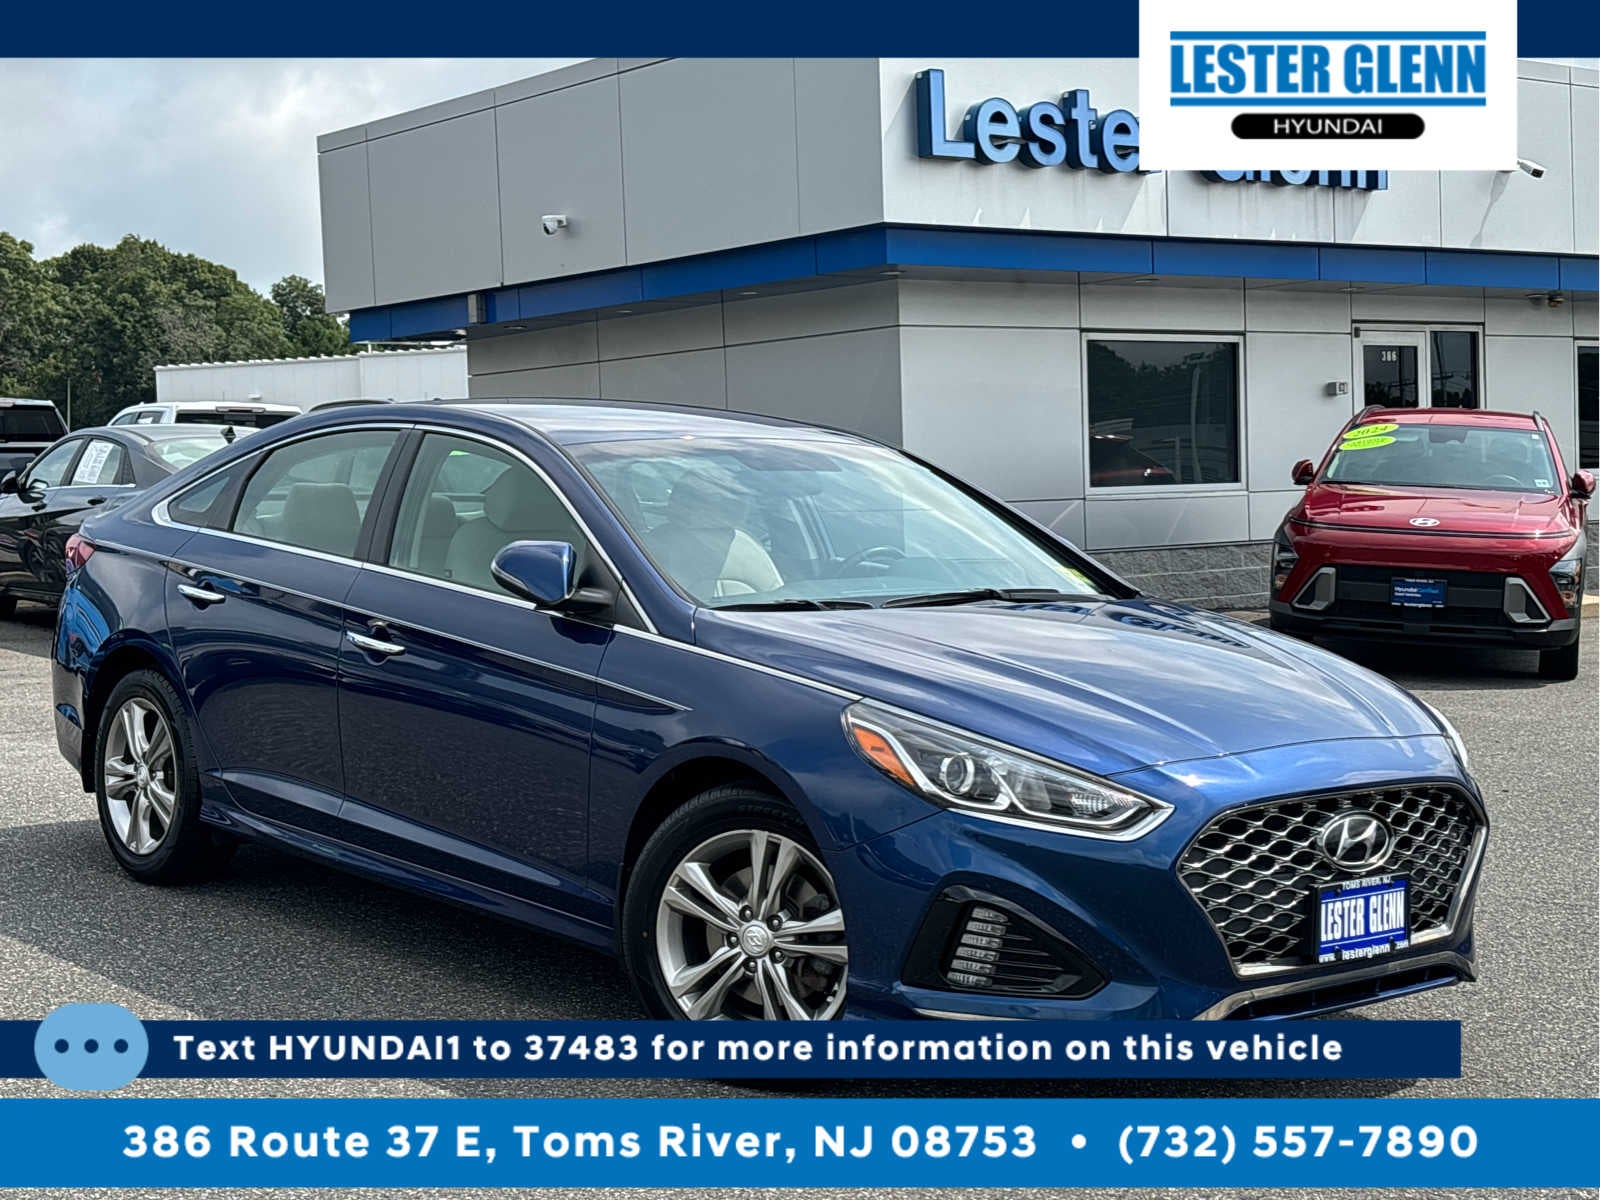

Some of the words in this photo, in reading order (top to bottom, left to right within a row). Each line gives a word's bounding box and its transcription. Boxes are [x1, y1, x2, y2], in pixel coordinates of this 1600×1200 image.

[914, 68, 1160, 173] Leste
[1381, 351, 1397, 362] 386
[1320, 897, 1365, 942] LESTER
[1369, 891, 1405, 934] GLENN
[1342, 943, 1391, 961] lesterglenn
